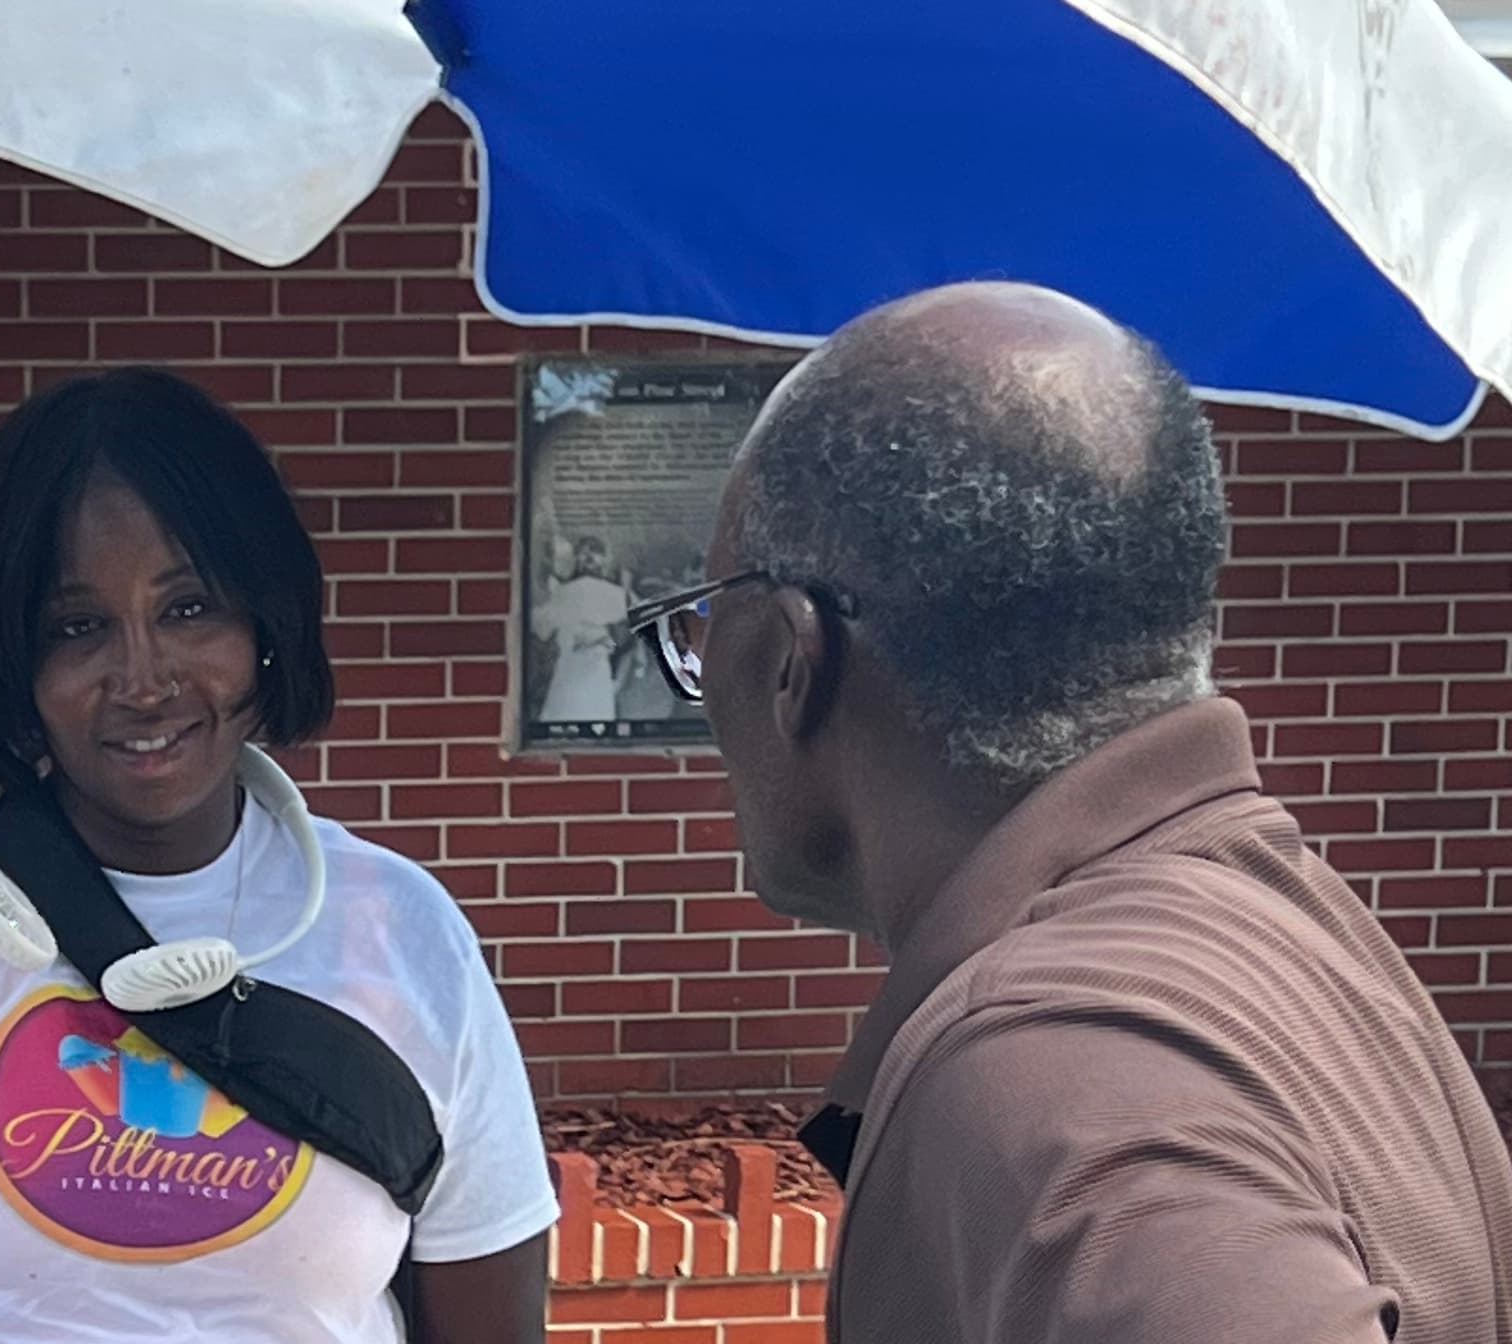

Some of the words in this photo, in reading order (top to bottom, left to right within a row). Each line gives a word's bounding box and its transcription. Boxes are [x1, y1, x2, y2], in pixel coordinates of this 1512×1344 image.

[0, 1107, 294, 1192] Pittman's
[61, 1178, 171, 1194] ITALIAN
[189, 1186, 230, 1200] ICE
